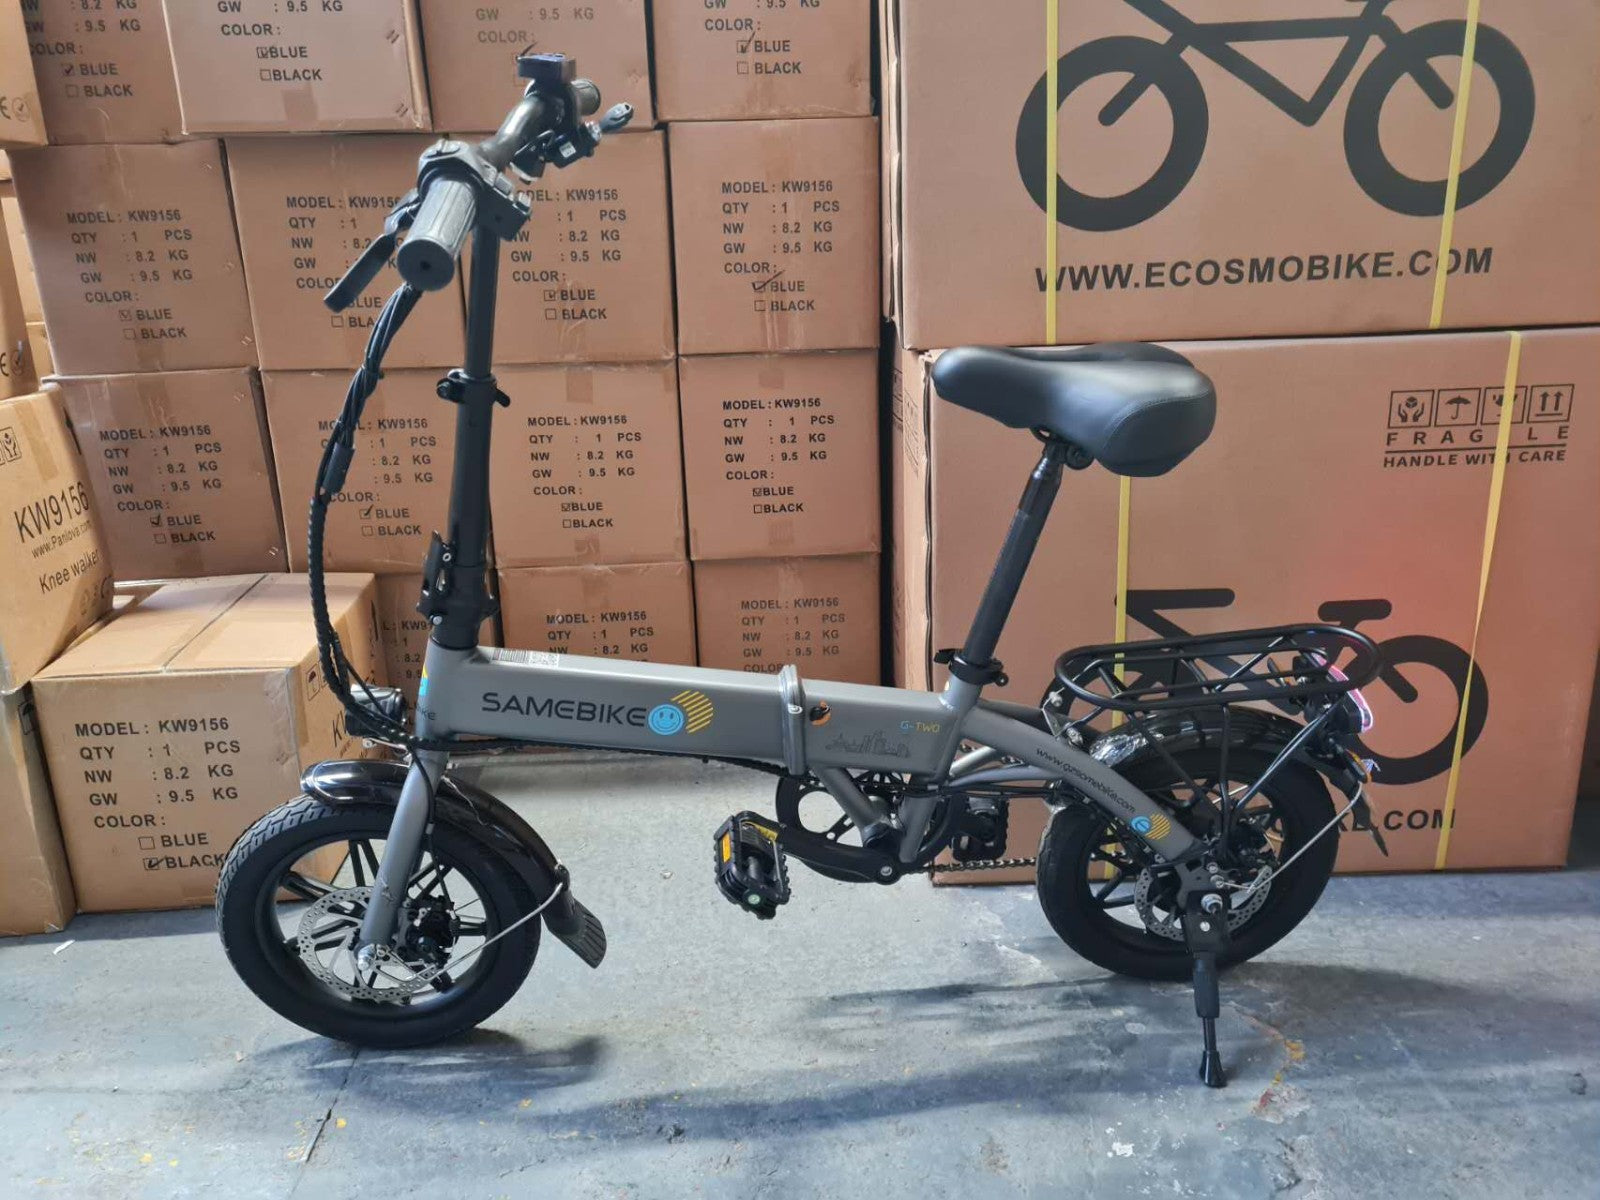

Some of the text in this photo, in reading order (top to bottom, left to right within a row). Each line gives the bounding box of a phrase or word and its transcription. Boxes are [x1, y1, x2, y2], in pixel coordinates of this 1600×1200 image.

[217, 1, 343, 13] GW 9.5 KG
[476, 7, 594, 21] GW 9.5 KG
[85, 19, 141, 32] 9.5 KG
[269, 46, 307, 58] BLUE
[754, 40, 790, 53] BLUE
[80, 64, 118, 76] BLUE
[754, 62, 801, 74] BLACK
[272, 68, 322, 81] BLACK
[84, 85, 133, 97] BLACK
[782, 180, 833, 192] KW9156
[566, 189, 618, 200] KW9156
[722, 201, 840, 214] QTY PCS
[128, 209, 181, 222] KW9156
[599, 209, 626, 221] PCS
[289, 217, 316, 229] QTY
[723, 222, 832, 234] NW 8.2 KG
[71, 229, 192, 244] QTY PCS
[569, 230, 620, 242] 8.2 KG
[292, 237, 313, 248] NW
[723, 242, 833, 254] GW 9.5 KG
[75, 249, 189, 264] NW 8.2 KG
[511, 250, 621, 262] GW 9.5 KG
[294, 258, 316, 268] GW
[80, 269, 193, 283] GW 9.5 KG
[1034, 247, 1492, 293] WWW.ECOSMOBIKE.COM
[770, 281, 805, 293] BLUE
[560, 289, 595, 300] BLUE
[770, 300, 815, 312] BLACK
[136, 309, 172, 321] BLUE
[562, 308, 607, 319] BLACK
[140, 328, 186, 339] BLACK
[774, 398, 821, 409] KW9156
[377, 419, 428, 429] KW9156
[580, 414, 627, 425] KW9156
[723, 414, 834, 428] QTY PCS
[159, 425, 211, 438] KW9156
[410, 436, 436, 446] PCS
[529, 432, 642, 445] QTY PCS
[724, 433, 826, 446] NW 8.2 KG
[104, 442, 222, 459] QTY PCS
[531, 449, 634, 461] NW 8.2 KG
[725, 450, 827, 463] GW 9.5 KG
[381, 455, 431, 466] 8.2 KG
[1383, 454, 1459, 468] HANDLE
[1519, 450, 1567, 463] CARE
[108, 460, 218, 477] NW 8.2 KG
[532, 466, 635, 479] GW 9.5 KG
[383, 473, 433, 484] 9.5 KG
[113, 478, 222, 495] GW 9.5 KG
[762, 486, 794, 496] BLUE
[14, 482, 89, 543] KW9156
[571, 501, 603, 512] BLUE
[763, 502, 804, 513] BLACK
[376, 508, 410, 519] BLUE
[166, 514, 201, 526] BLUE
[573, 518, 613, 529] BLACK
[378, 525, 421, 536] BLACK
[170, 530, 216, 544] BLACK
[40, 565, 70, 594] Knee
[793, 598, 839, 609] KW9156
[600, 611, 647, 623] KW9156
[741, 613, 845, 627] QTY PCS
[547, 627, 654, 641] QTY PCS
[742, 630, 839, 642] NW 8.2 KG
[602, 643, 648, 655] 8.2 KG
[742, 645, 840, 658] GW 9.5 KG
[481, 692, 646, 728] SAMEBIKE
[158, 717, 229, 734] KW9156
[79, 740, 240, 761] QTY 1 PCS
[84, 764, 233, 783] NW 8.2 KG
[89, 787, 238, 806] GW 9.5 KG
[161, 832, 209, 847] BLUE
[165, 853, 225, 869] BLACK
